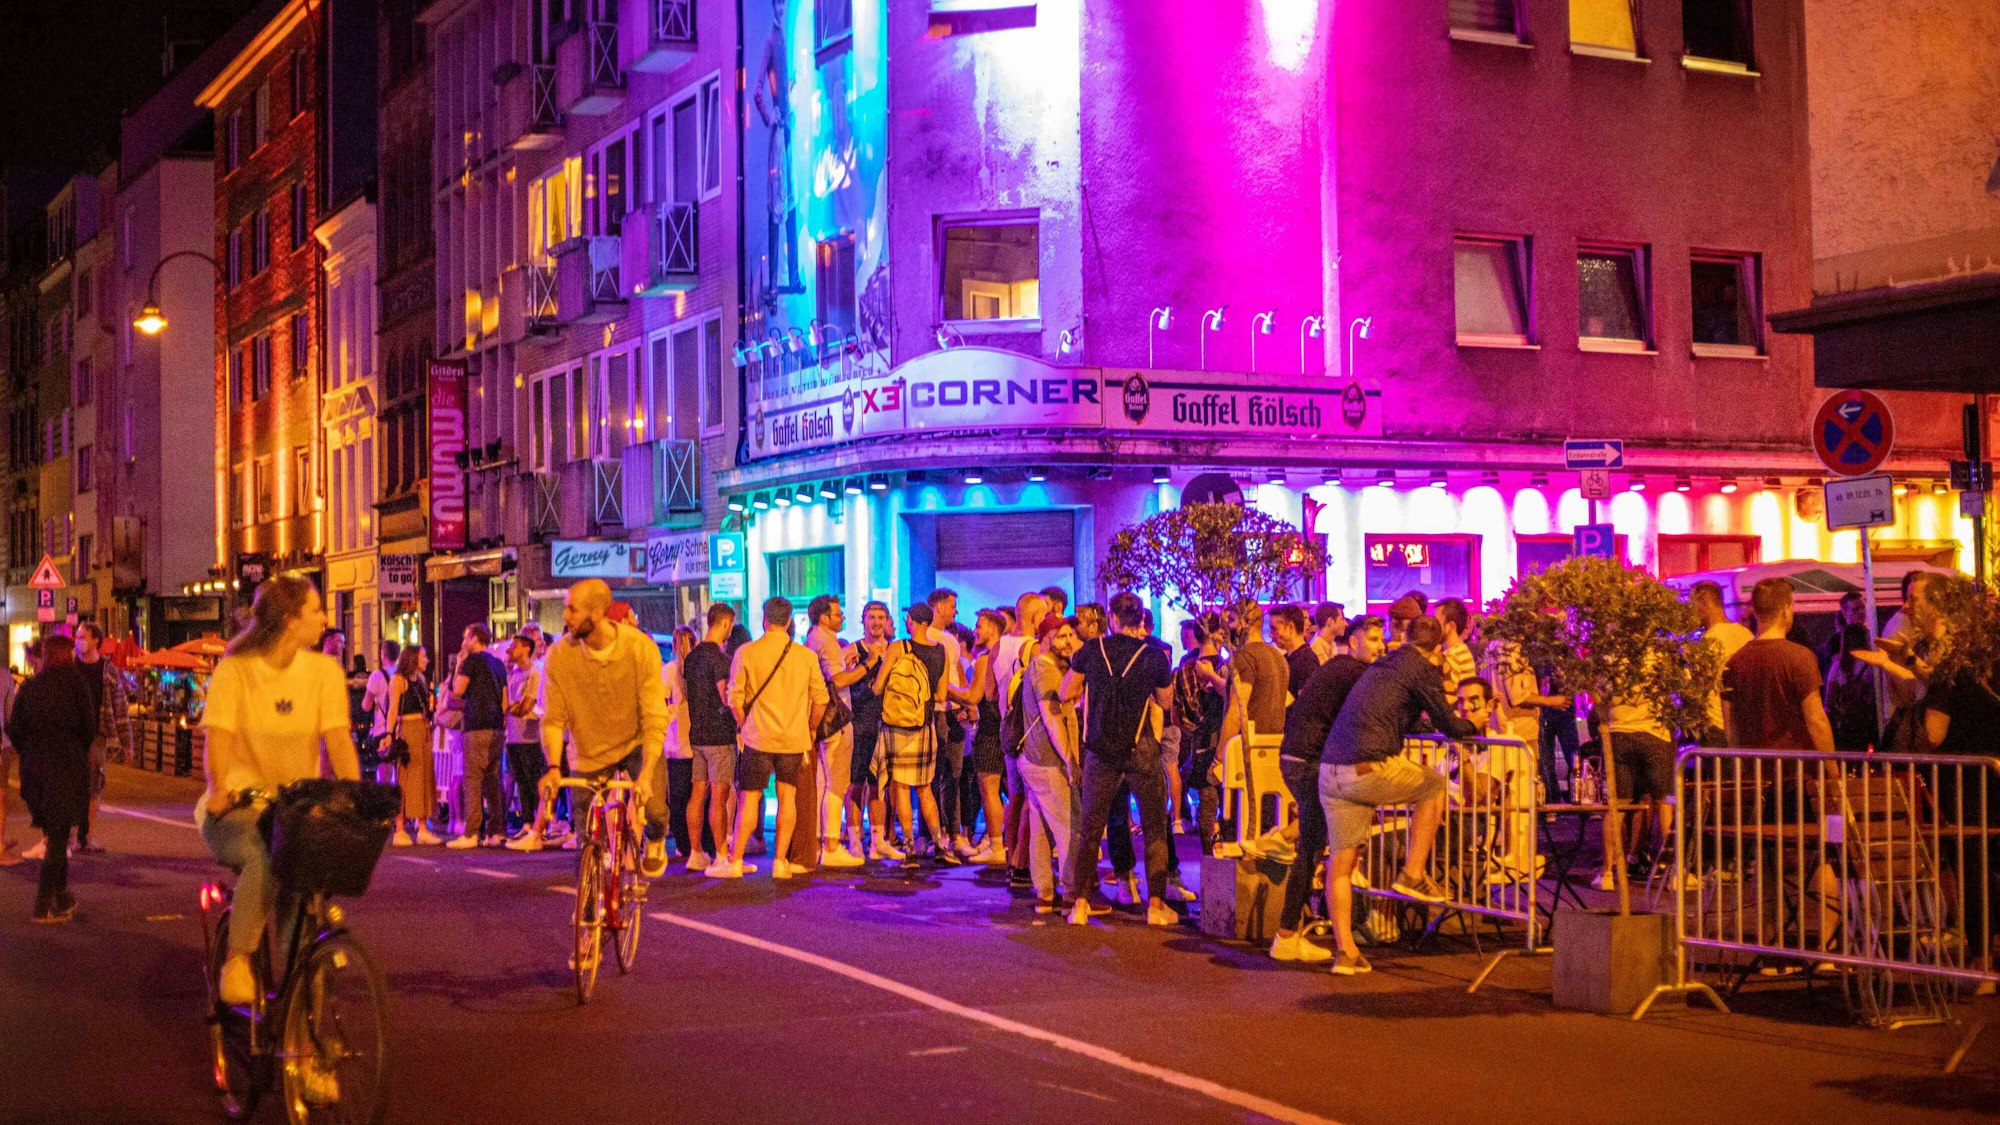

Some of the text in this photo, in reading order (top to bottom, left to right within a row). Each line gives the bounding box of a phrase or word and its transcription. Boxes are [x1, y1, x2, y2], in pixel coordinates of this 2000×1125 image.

[430, 365, 464, 377] Gilden
[432, 388, 455, 407] die
[910, 379, 1100, 408] CORNER
[1173, 393, 1322, 430] Gaffel Kölsch
[772, 414, 799, 447] Gaffel
[801, 406, 834, 443] Kölsch
[685, 537, 708, 557] Schne
[717, 538, 735, 566] P
[1581, 530, 1601, 557] P
[380, 554, 413, 566] Kölsch
[389, 572, 412, 585] to go
[40, 591, 51, 606] P
